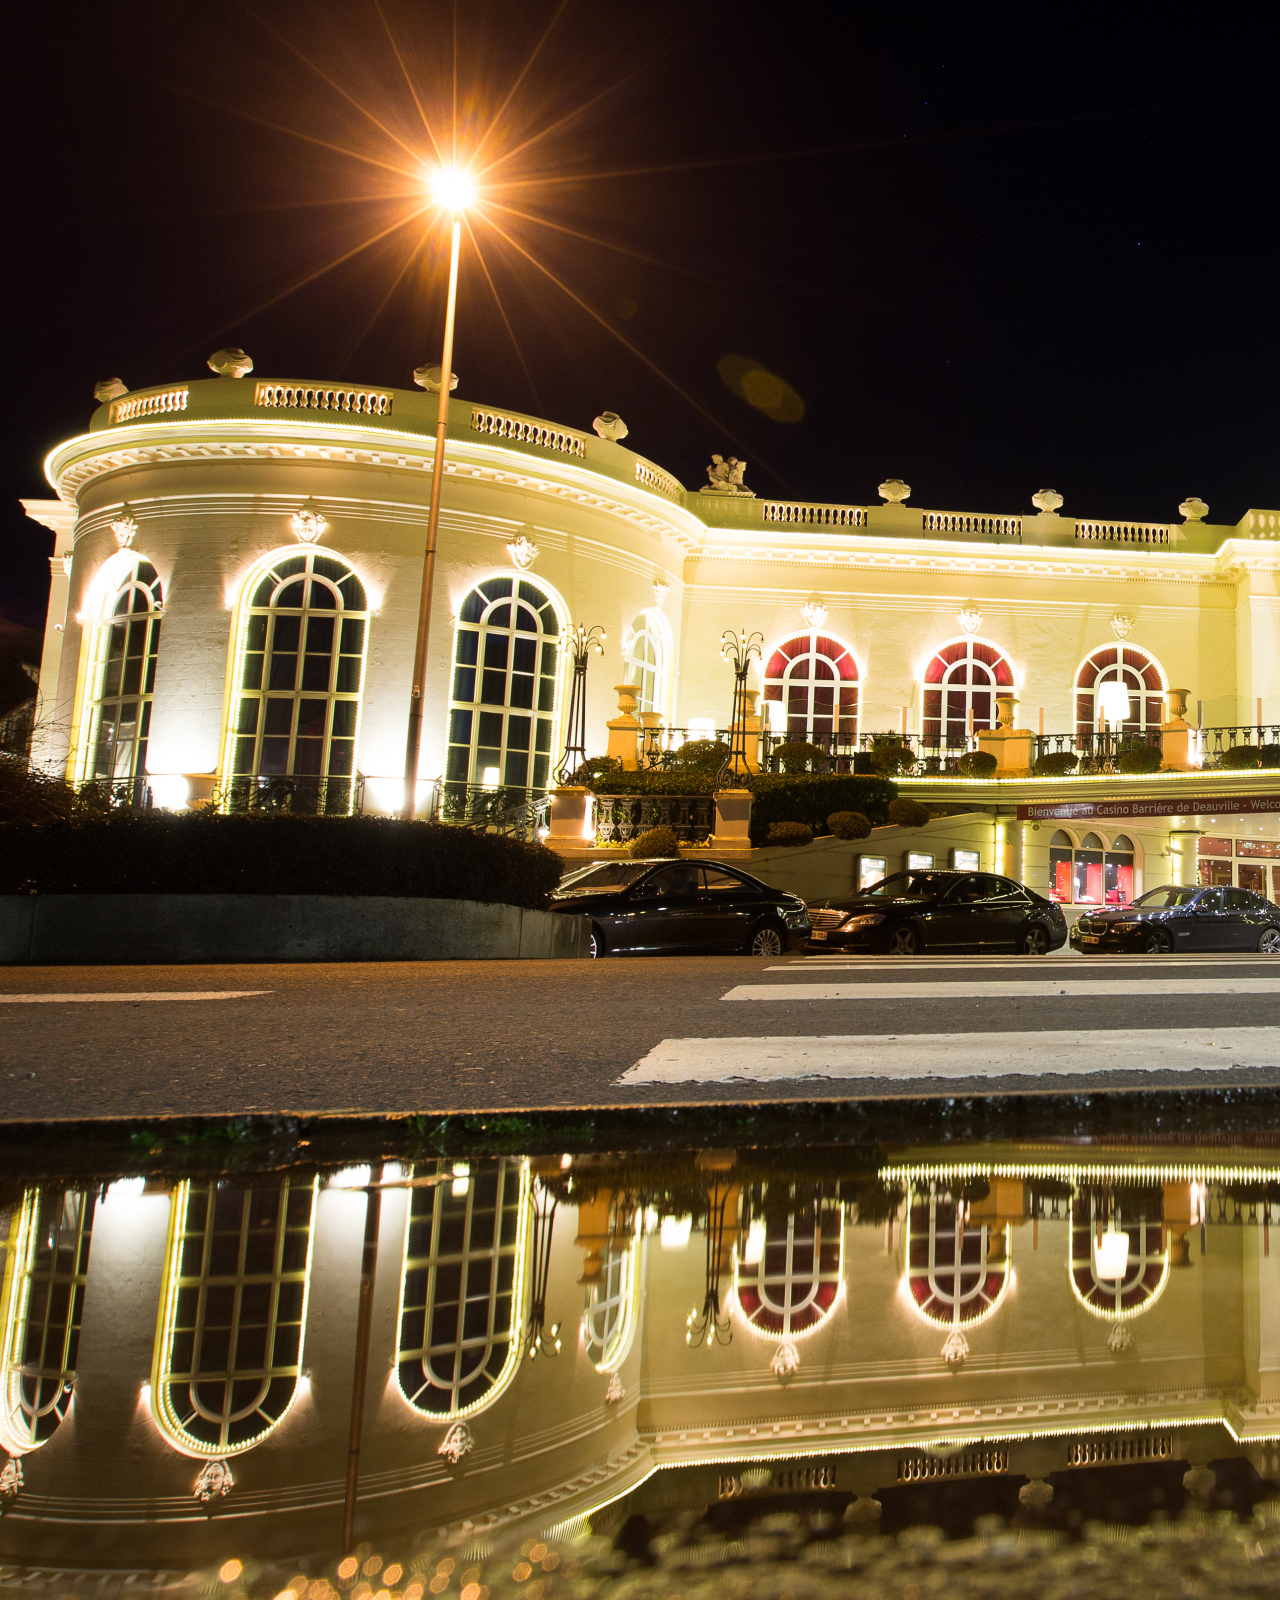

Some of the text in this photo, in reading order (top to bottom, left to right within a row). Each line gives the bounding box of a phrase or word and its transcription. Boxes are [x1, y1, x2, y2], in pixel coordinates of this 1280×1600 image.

[1027, 806, 1079, 818] Bienvenue
[1081, 807, 1094, 815] au
[1096, 805, 1130, 815] Casino
[1132, 803, 1174, 813] Barrière
[1177, 802, 1190, 812] de
[1193, 801, 1240, 811] Deauville
